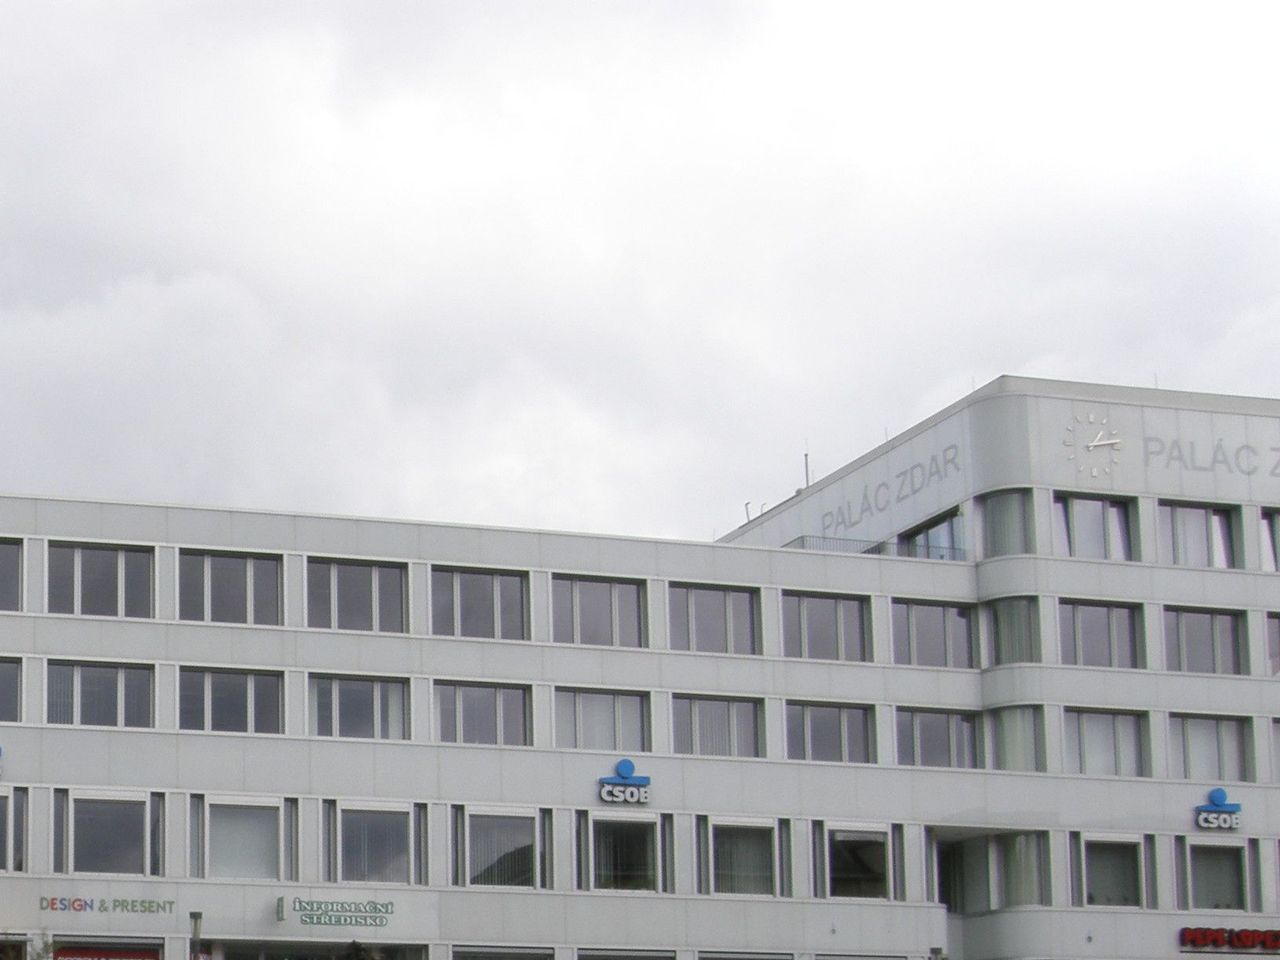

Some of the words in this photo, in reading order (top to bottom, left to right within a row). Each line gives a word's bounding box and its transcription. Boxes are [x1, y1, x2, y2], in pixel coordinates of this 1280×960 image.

[600, 783, 650, 803] ČSOB
[1197, 812, 1242, 829] ČSOB
[39, 897, 94, 912] DESIGN
[98, 900, 109, 912] &
[112, 899, 175, 913] PRESENT
[293, 897, 394, 915] INFORMAČNÍ
[300, 913, 388, 927] STŘEDISKO
[1179, 926, 1227, 948] PEPE
